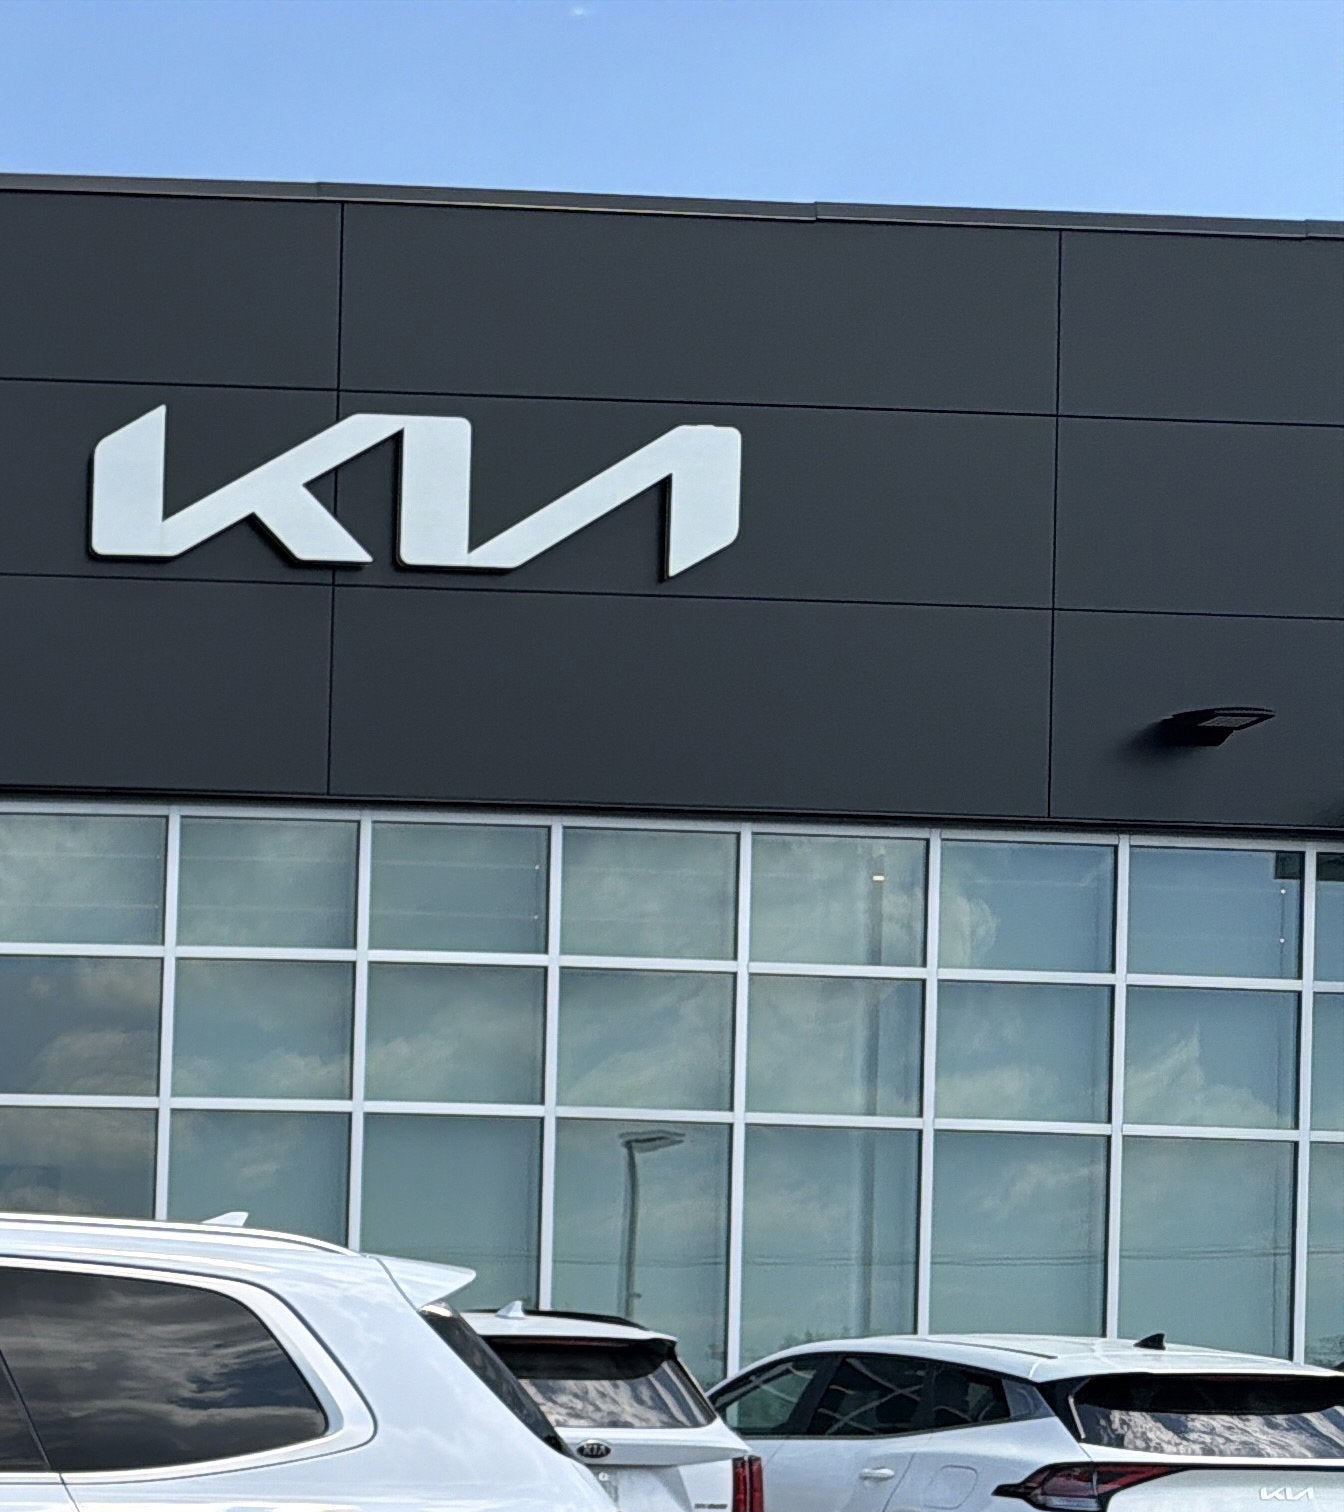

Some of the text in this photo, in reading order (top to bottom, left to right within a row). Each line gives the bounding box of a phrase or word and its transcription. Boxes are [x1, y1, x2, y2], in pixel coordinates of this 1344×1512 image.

[90, 405, 742, 579] KIA
[582, 1442, 607, 1456] KIA
[1259, 1487, 1314, 1501] KIA
